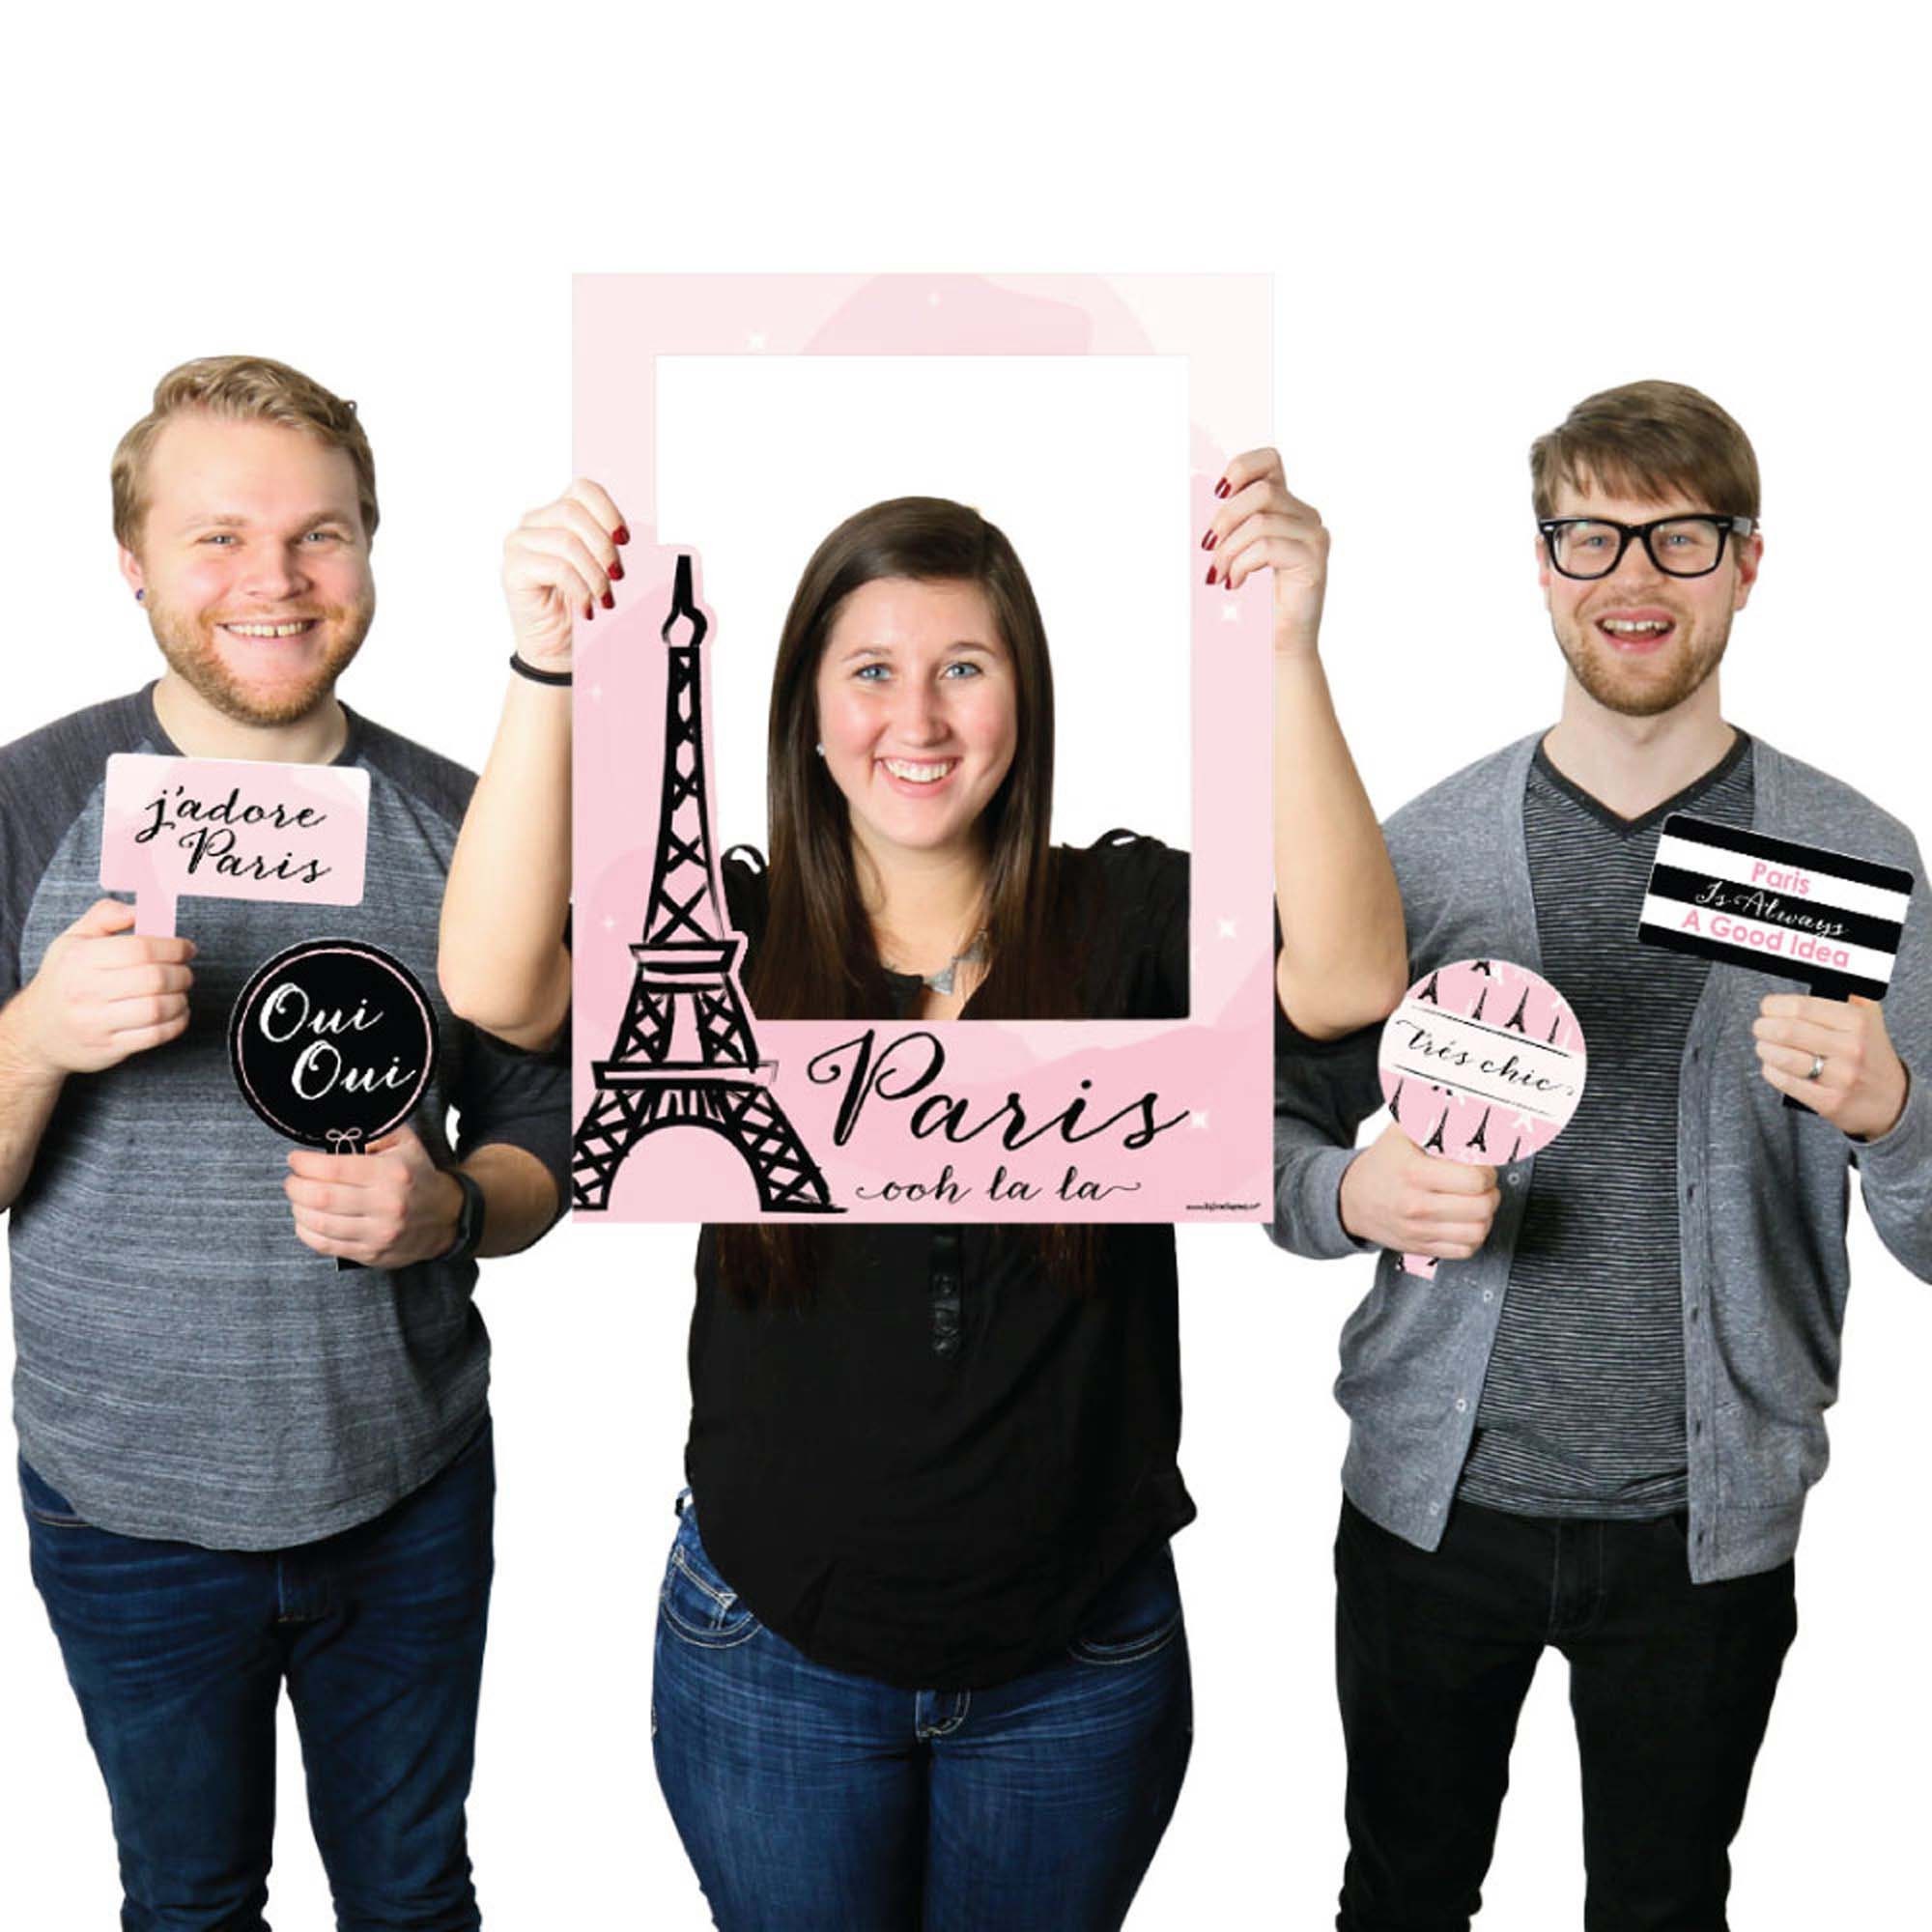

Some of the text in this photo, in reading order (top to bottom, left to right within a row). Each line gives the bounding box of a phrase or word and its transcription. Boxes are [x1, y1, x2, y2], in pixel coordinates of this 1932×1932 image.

[135, 785, 327, 843] j'adore
[179, 827, 332, 883] Paris
[1750, 862, 1811, 895] Paris
[1695, 881, 1850, 938] Is Always
[1681, 909, 1850, 969] A Good Idea
[259, 981, 384, 1043] Oui
[291, 1038, 416, 1100] Oui
[807, 1029, 1190, 1151] Paris
[1480, 1055, 1576, 1097] chic
[855, 1165, 1142, 1204] ooh la la
